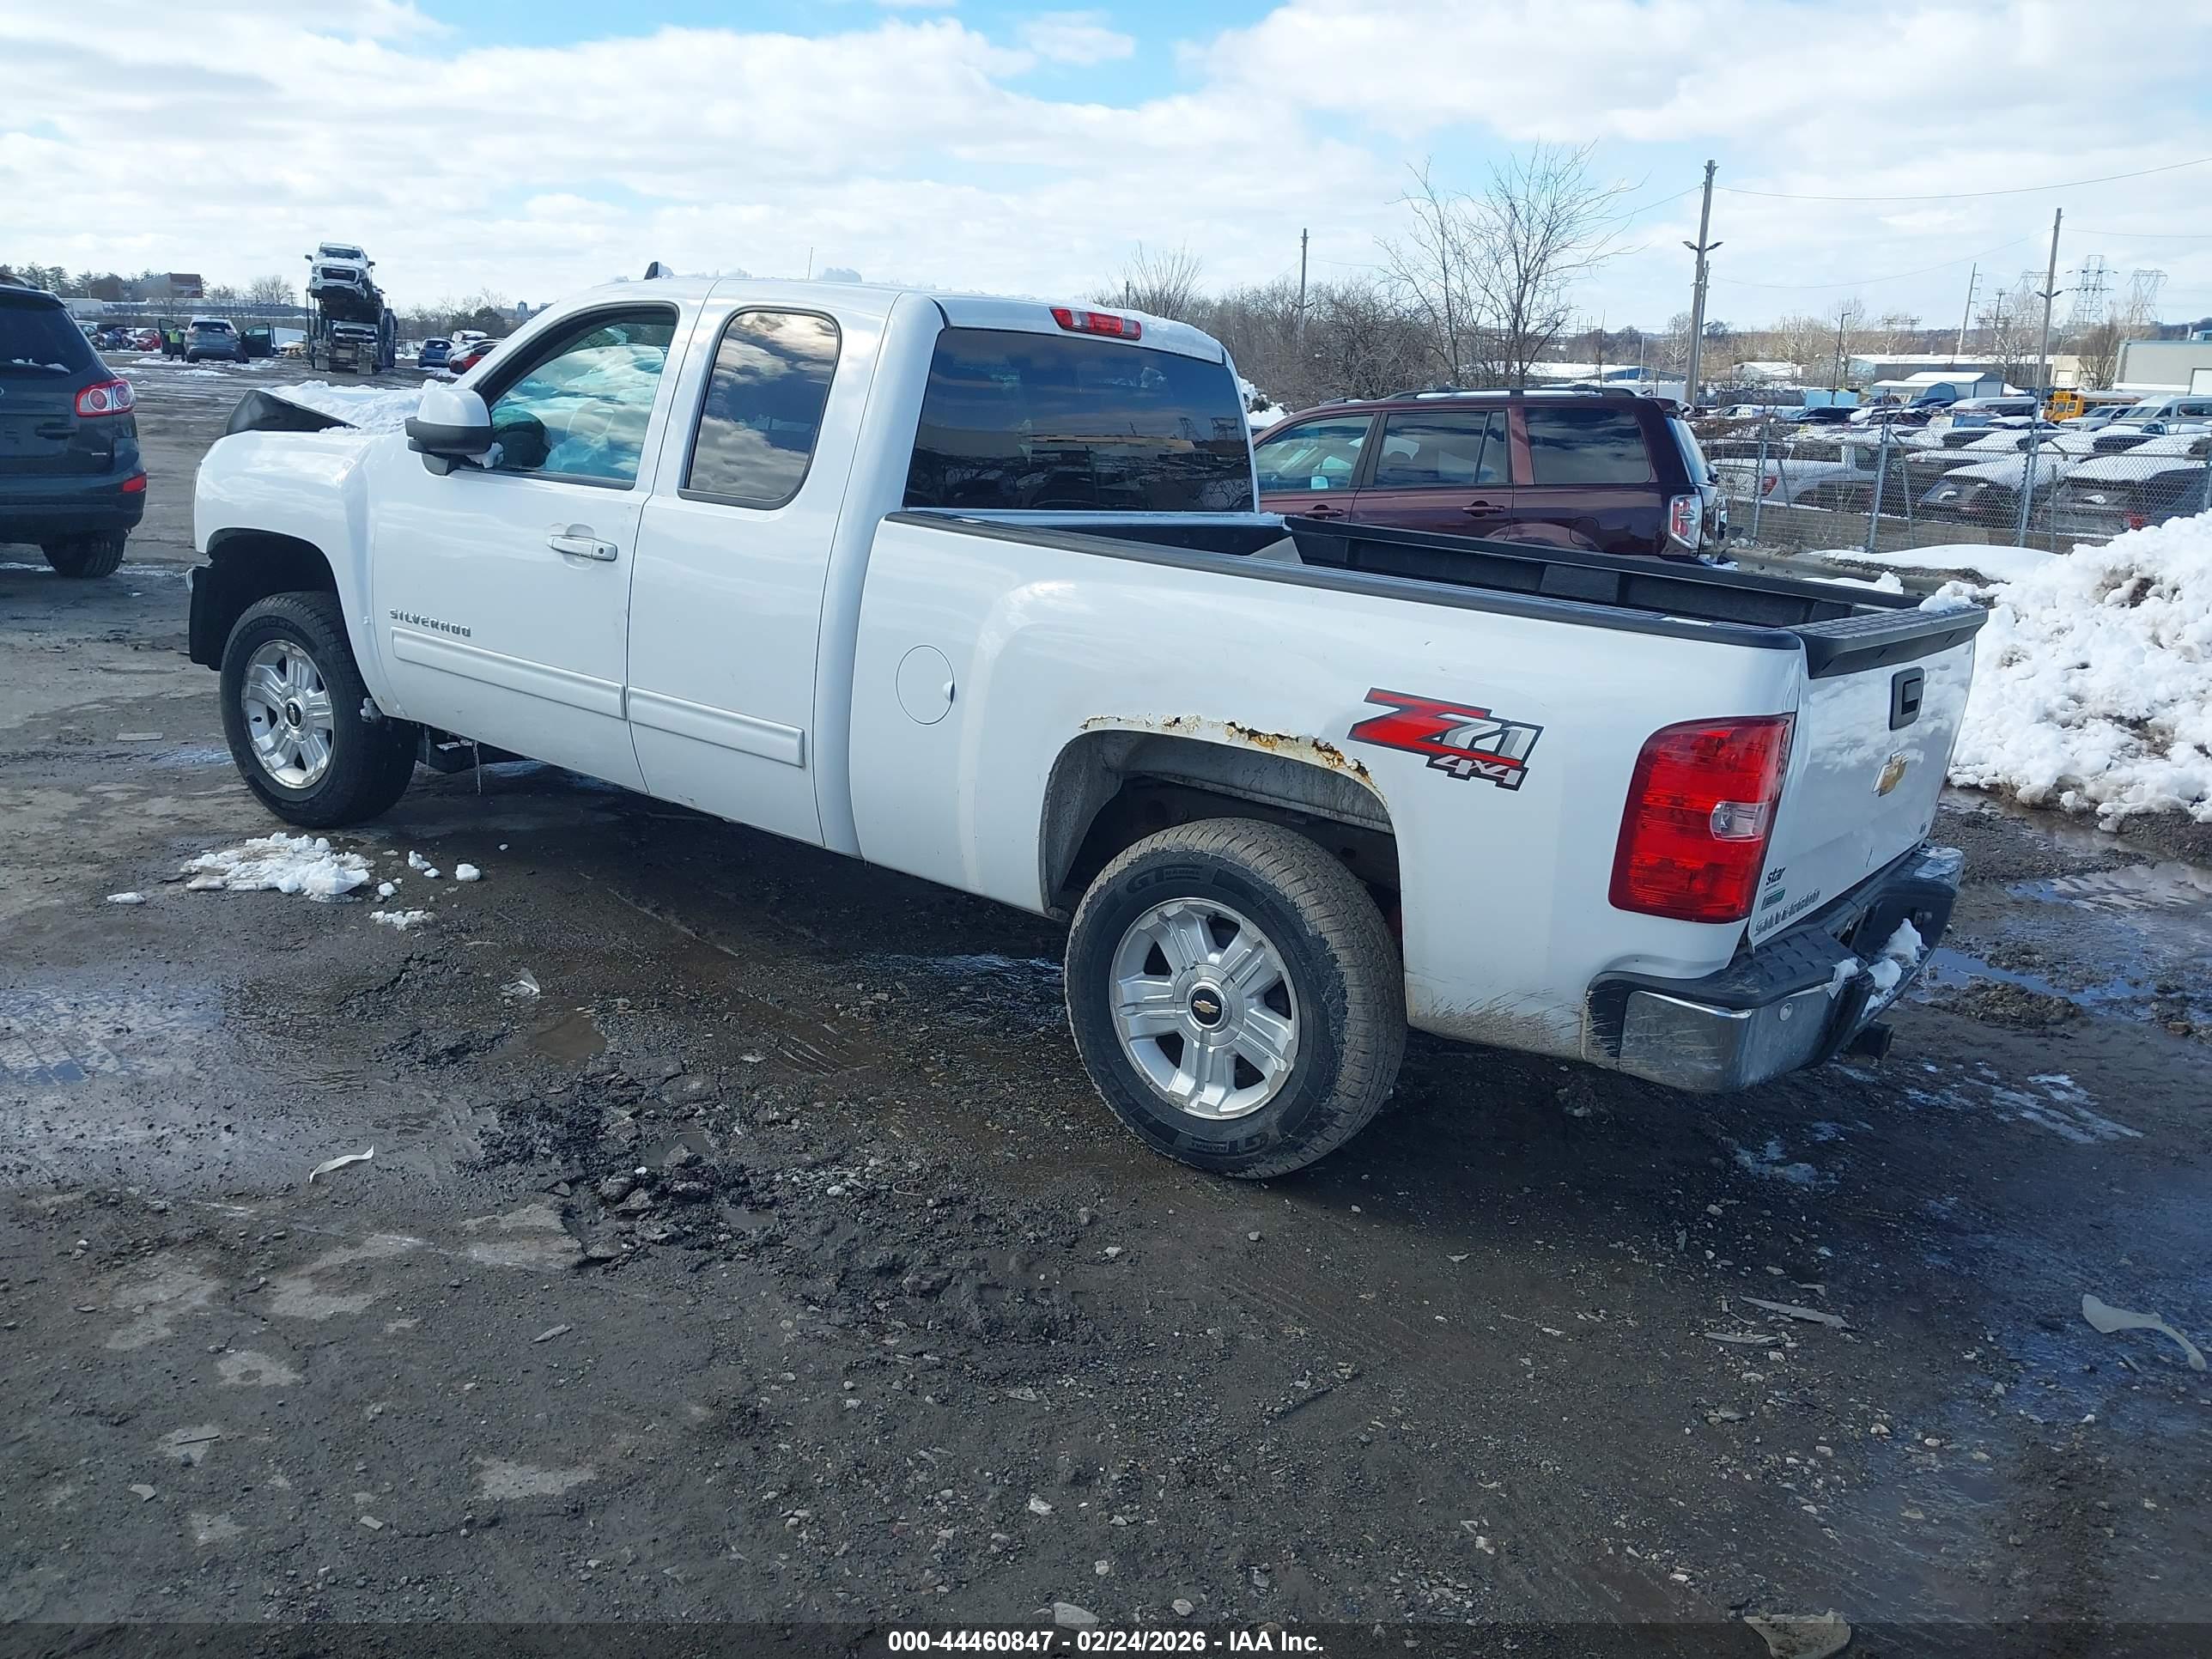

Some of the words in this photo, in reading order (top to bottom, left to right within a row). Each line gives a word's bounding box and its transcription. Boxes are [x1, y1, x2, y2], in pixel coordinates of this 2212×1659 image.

[389, 608, 471, 638] SILVERADO
[1346, 687, 1545, 769] Z71
[1765, 866, 1787, 886] star
